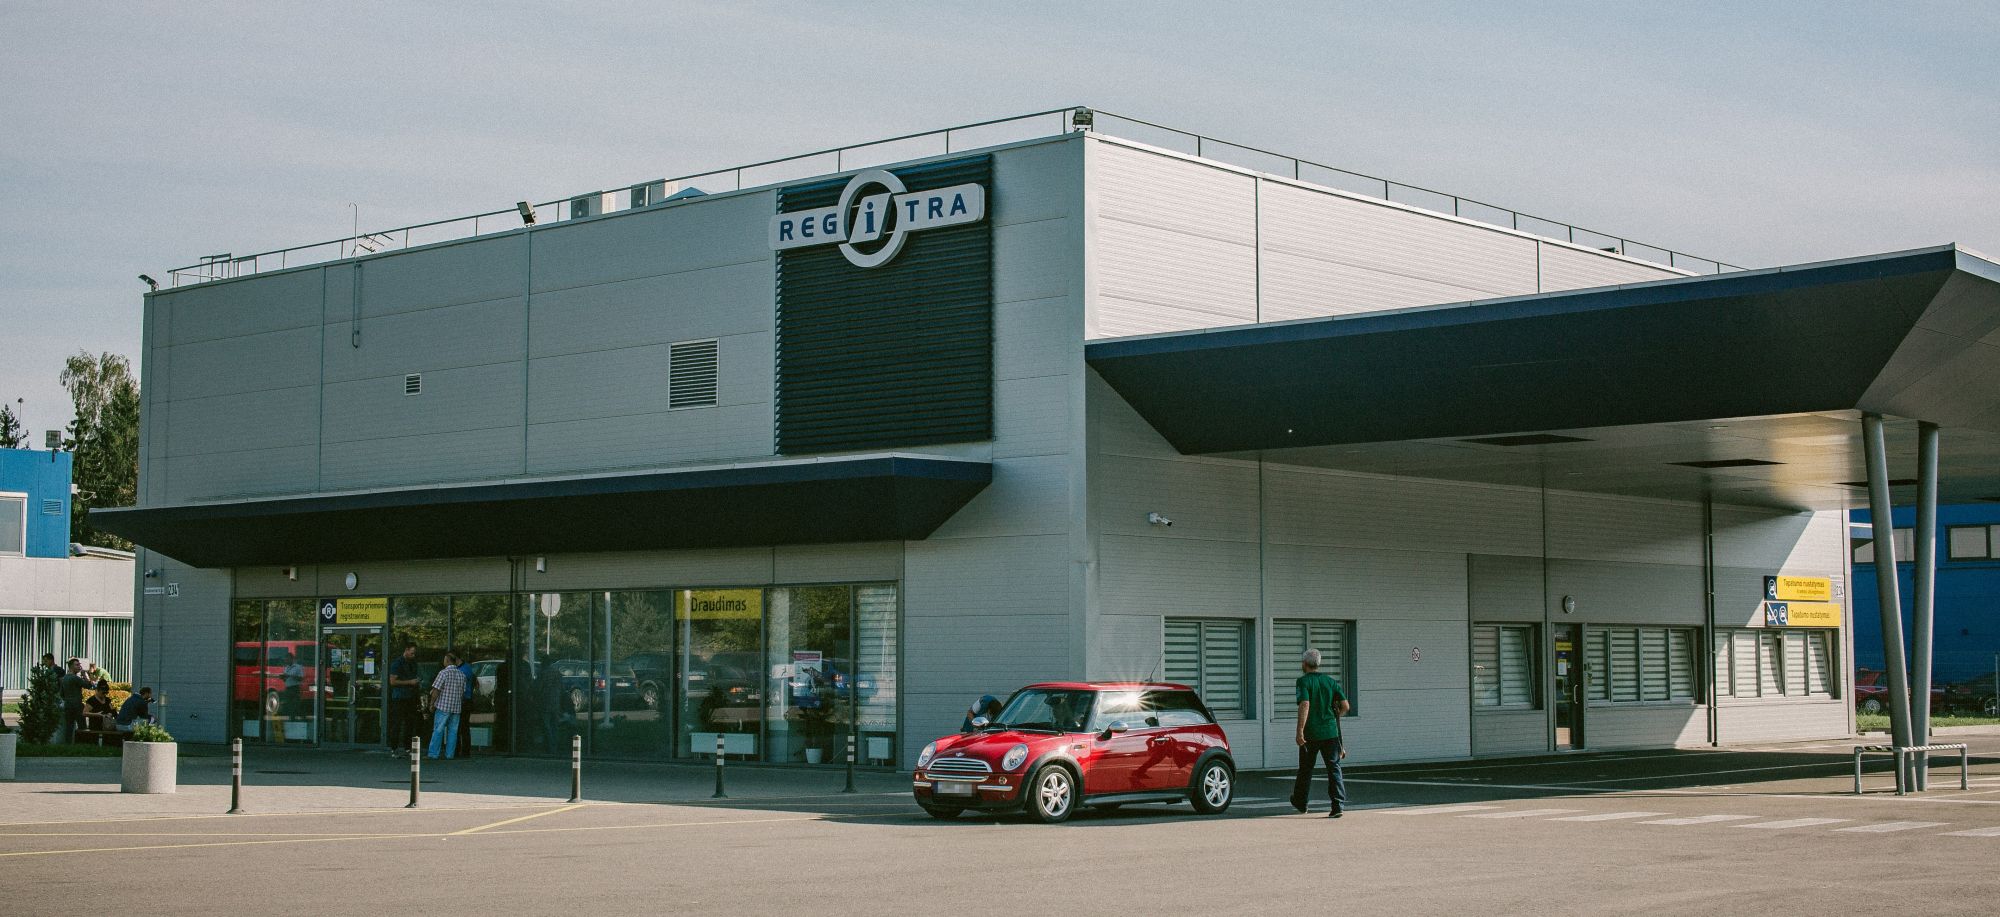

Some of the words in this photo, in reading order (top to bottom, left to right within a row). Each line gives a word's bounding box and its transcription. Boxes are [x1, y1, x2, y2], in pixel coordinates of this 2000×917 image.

[168, 584, 178, 596] 234
[340, 601, 364, 611] Transporto
[691, 595, 747, 612] Draudimas
[340, 612, 370, 621] registravimas
